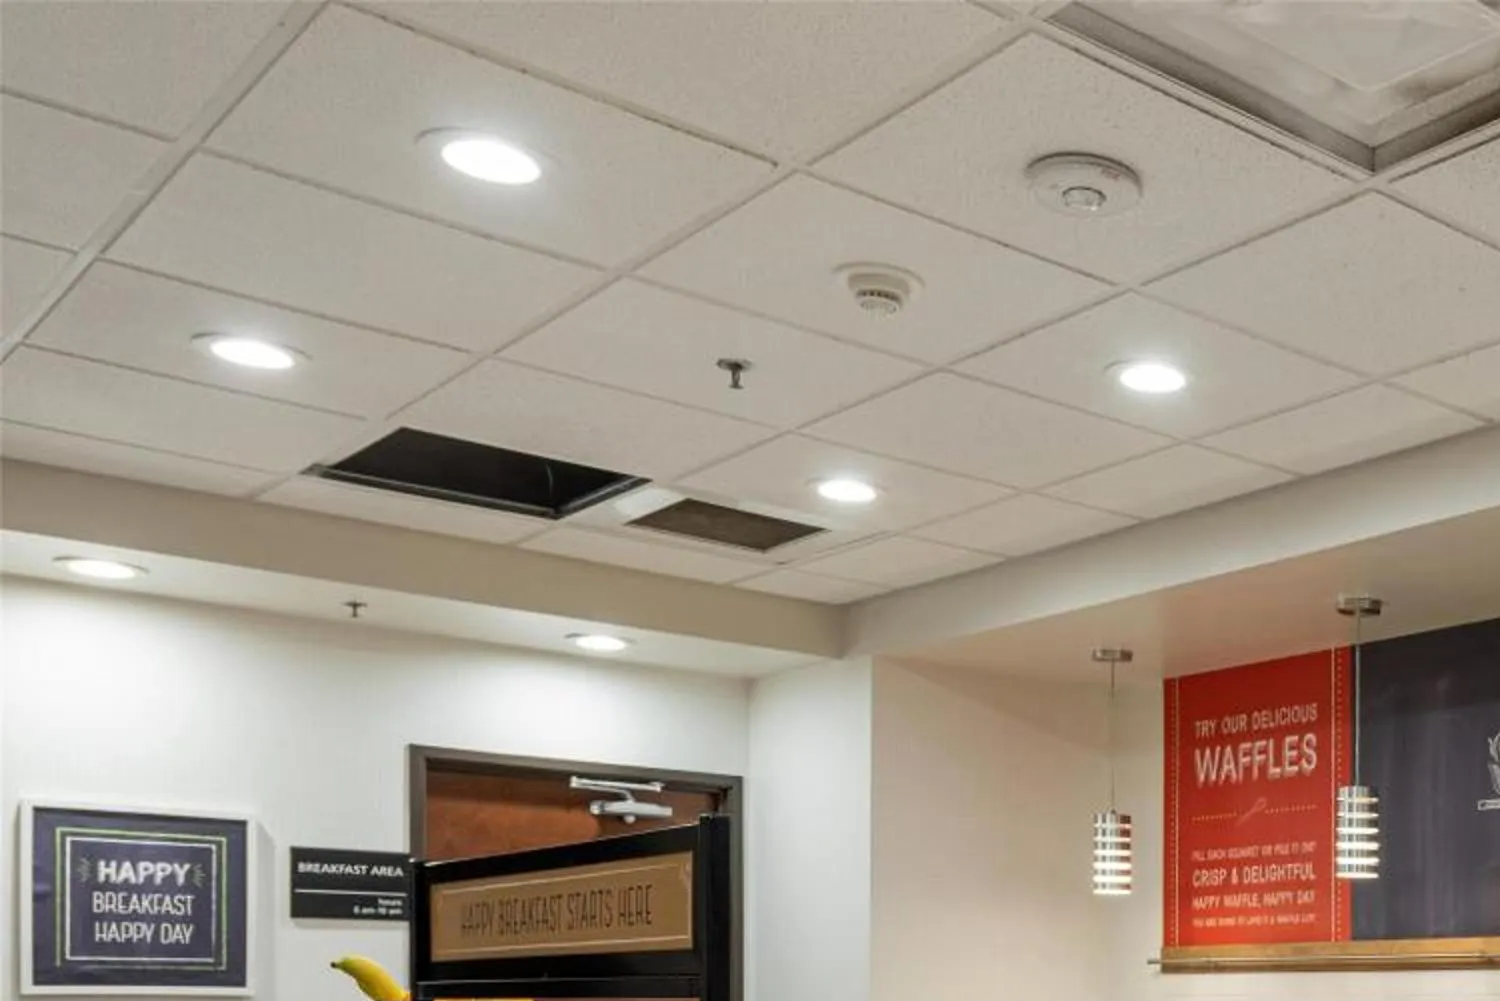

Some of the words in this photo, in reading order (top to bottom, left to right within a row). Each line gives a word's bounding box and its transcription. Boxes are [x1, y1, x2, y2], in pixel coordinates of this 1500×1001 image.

[1194, 719, 1217, 739] TRY
[1221, 713, 1248, 735] OUR
[1251, 702, 1318, 731] DELICIOUS
[1194, 732, 1318, 789] WAFFLES
[98, 859, 192, 887] HAPPY
[297, 861, 370, 876] BREAKFAST
[370, 865, 404, 877] AREA
[1192, 867, 1228, 888] CRISP
[1243, 861, 1316, 884] DELIGHTFUL
[92, 891, 196, 917] BREAKFAST
[461, 900, 495, 937] HAPPY
[499, 893, 564, 936] BREAKFAST
[567, 889, 614, 930] STARTS
[619, 884, 653, 926] HERE
[94, 922, 155, 945] HAPPY
[160, 924, 195, 946] DAY
